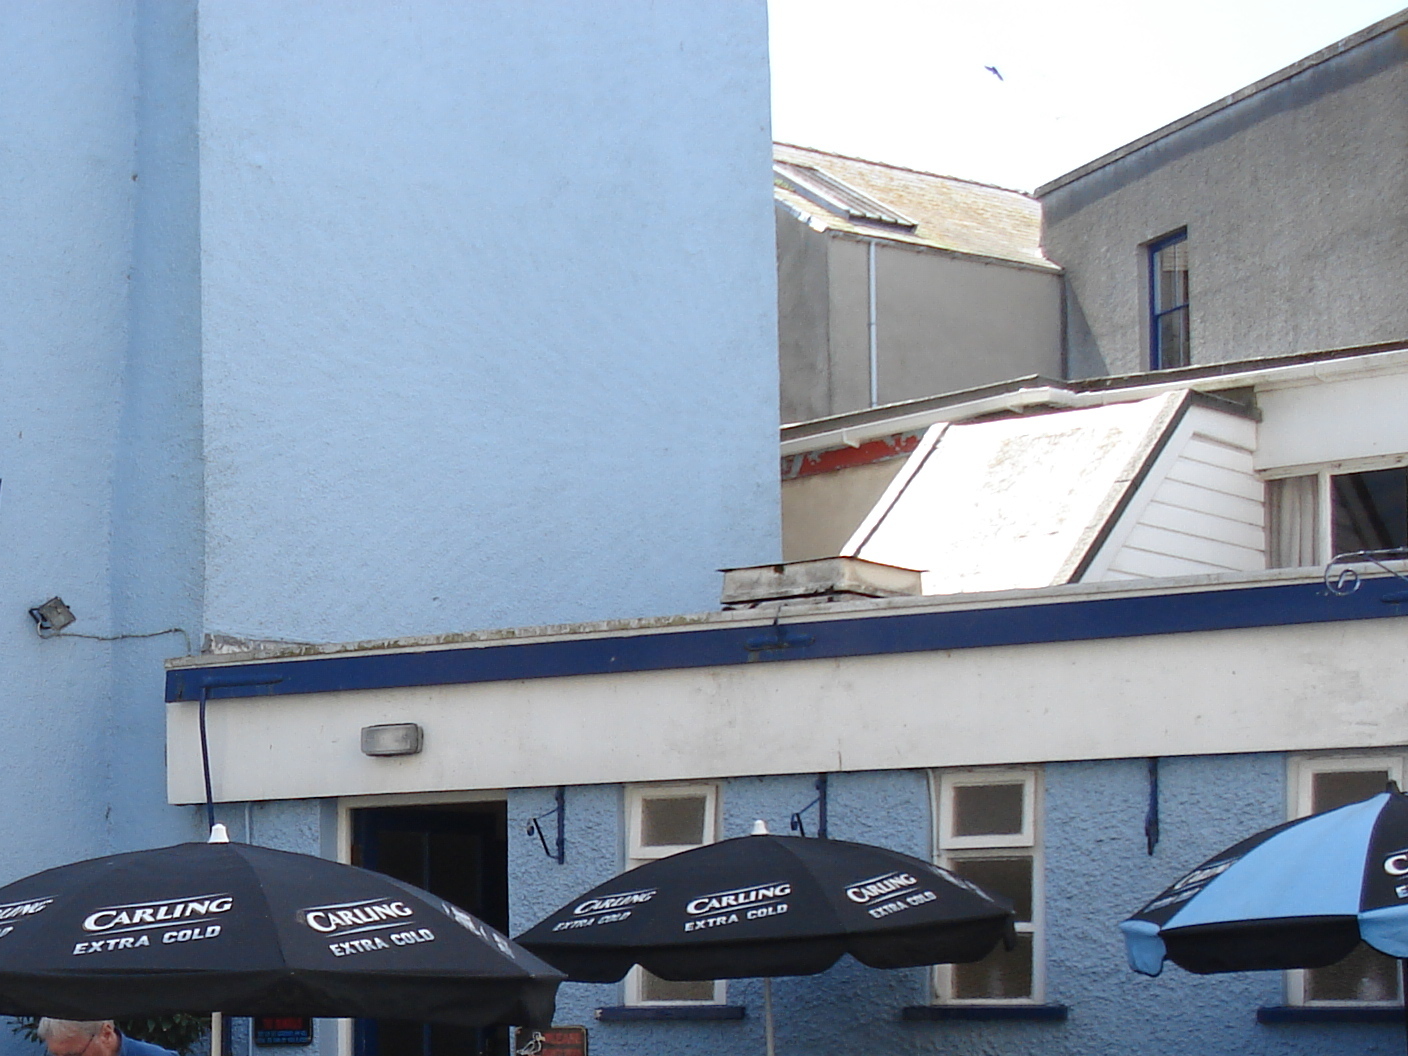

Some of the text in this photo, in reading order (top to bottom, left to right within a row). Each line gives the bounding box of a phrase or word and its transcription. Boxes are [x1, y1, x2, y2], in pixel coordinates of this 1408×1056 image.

[686, 883, 791, 915] CARLING
[846, 873, 918, 903] CARLING
[83, 897, 233, 931] CARLING
[306, 901, 413, 932] CARLING
[684, 903, 788, 932] EXTRA COLD
[868, 890, 937, 919] EXTRA COLD
[72, 925, 222, 956] EXTRA COLD
[329, 928, 435, 957] EXTRA COLD
